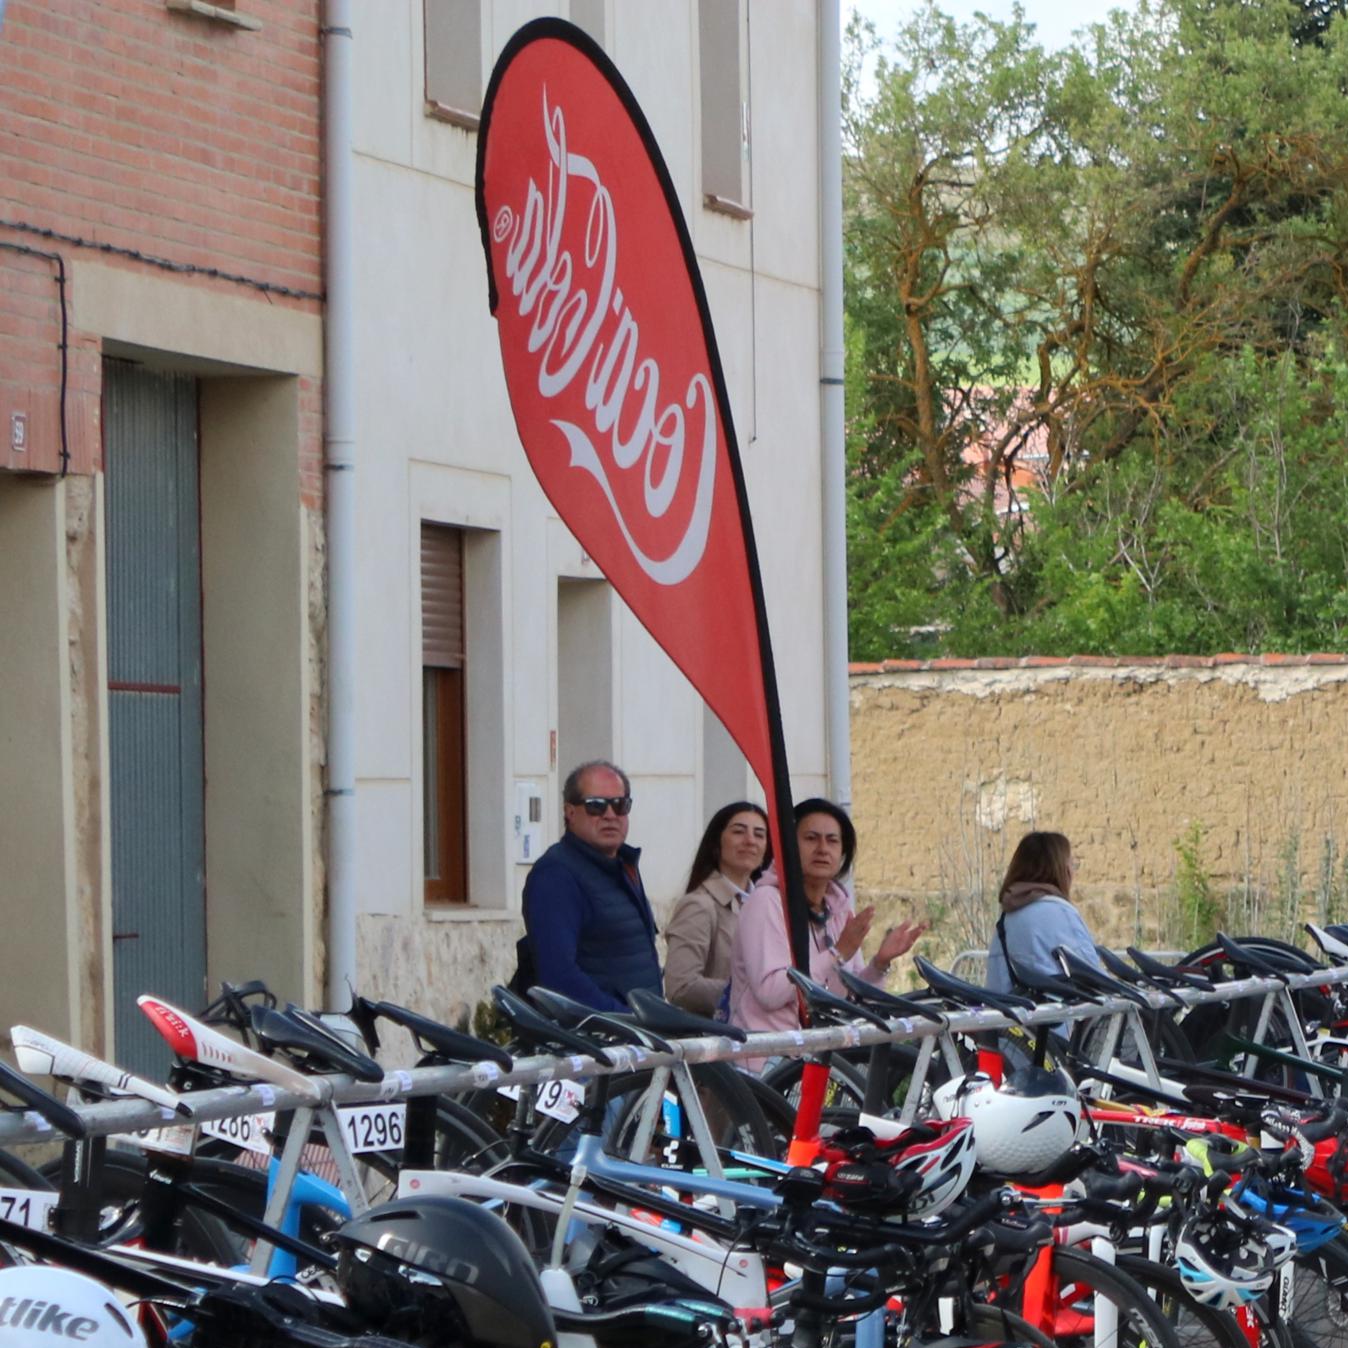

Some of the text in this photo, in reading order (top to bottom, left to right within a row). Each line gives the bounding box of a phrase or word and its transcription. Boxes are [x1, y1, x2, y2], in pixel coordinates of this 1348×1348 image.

[347, 1111, 402, 1150] 1296
[1132, 1115, 1176, 1128] TREK
[378, 1233, 479, 1284] GIRO
